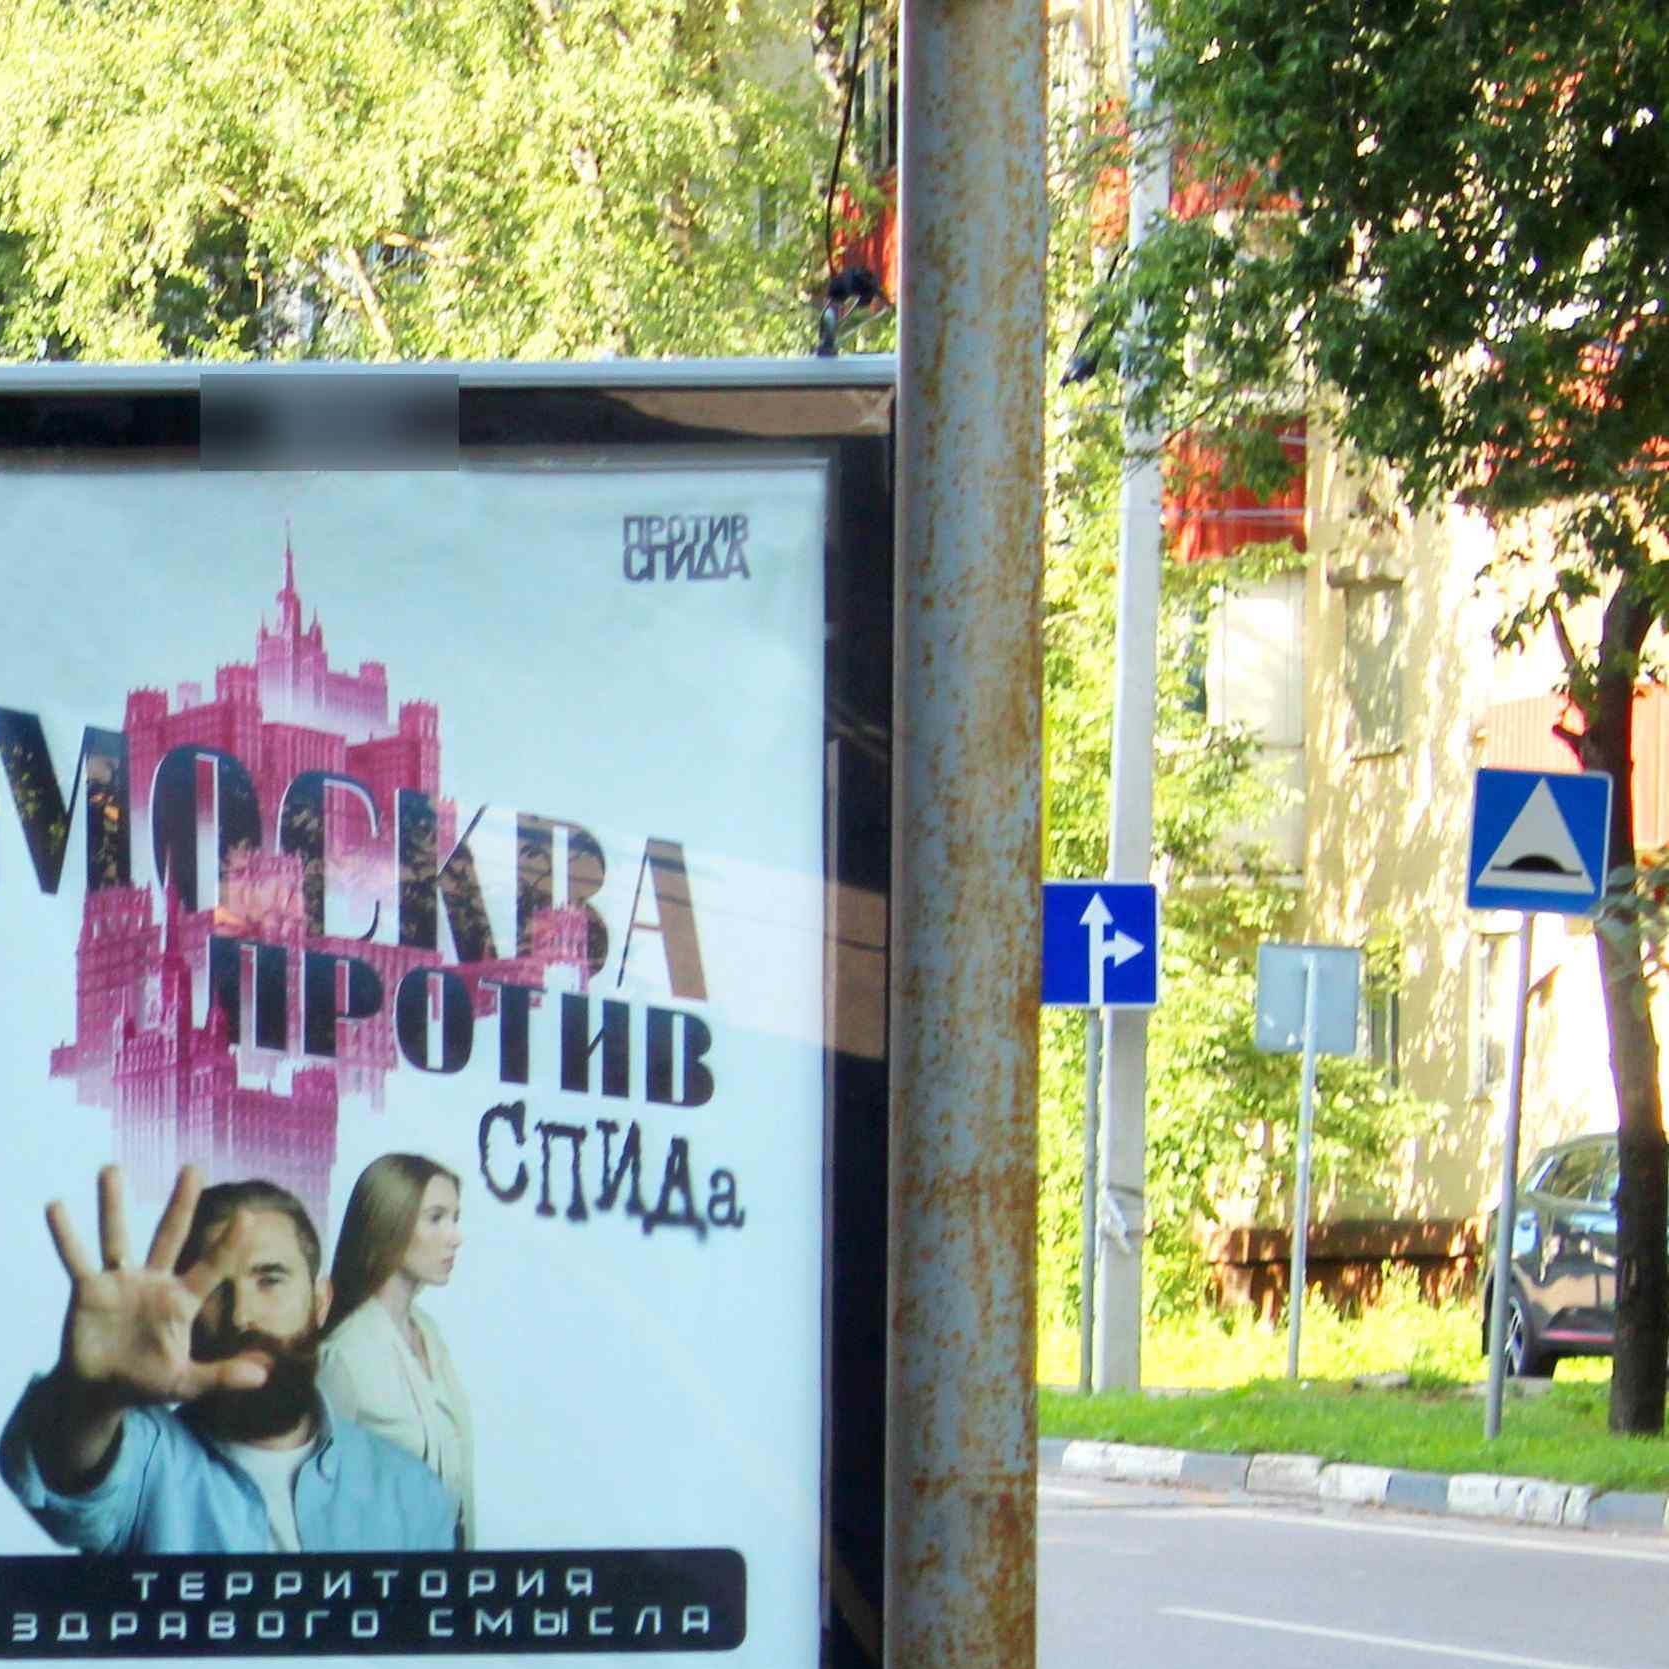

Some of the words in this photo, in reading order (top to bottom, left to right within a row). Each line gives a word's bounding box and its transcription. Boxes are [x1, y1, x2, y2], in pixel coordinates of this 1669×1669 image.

[622, 514, 750, 546] ПРОТИВ
[622, 543, 752, 582] СПИДА
[207, 934, 717, 1109] ПРОТИВ
[131, 1567, 595, 1602] ТЕРРИТОРИЯ
[10, 1608, 381, 1643] ЗДРАВОГО
[428, 1604, 711, 1639] СМЫСЛА
